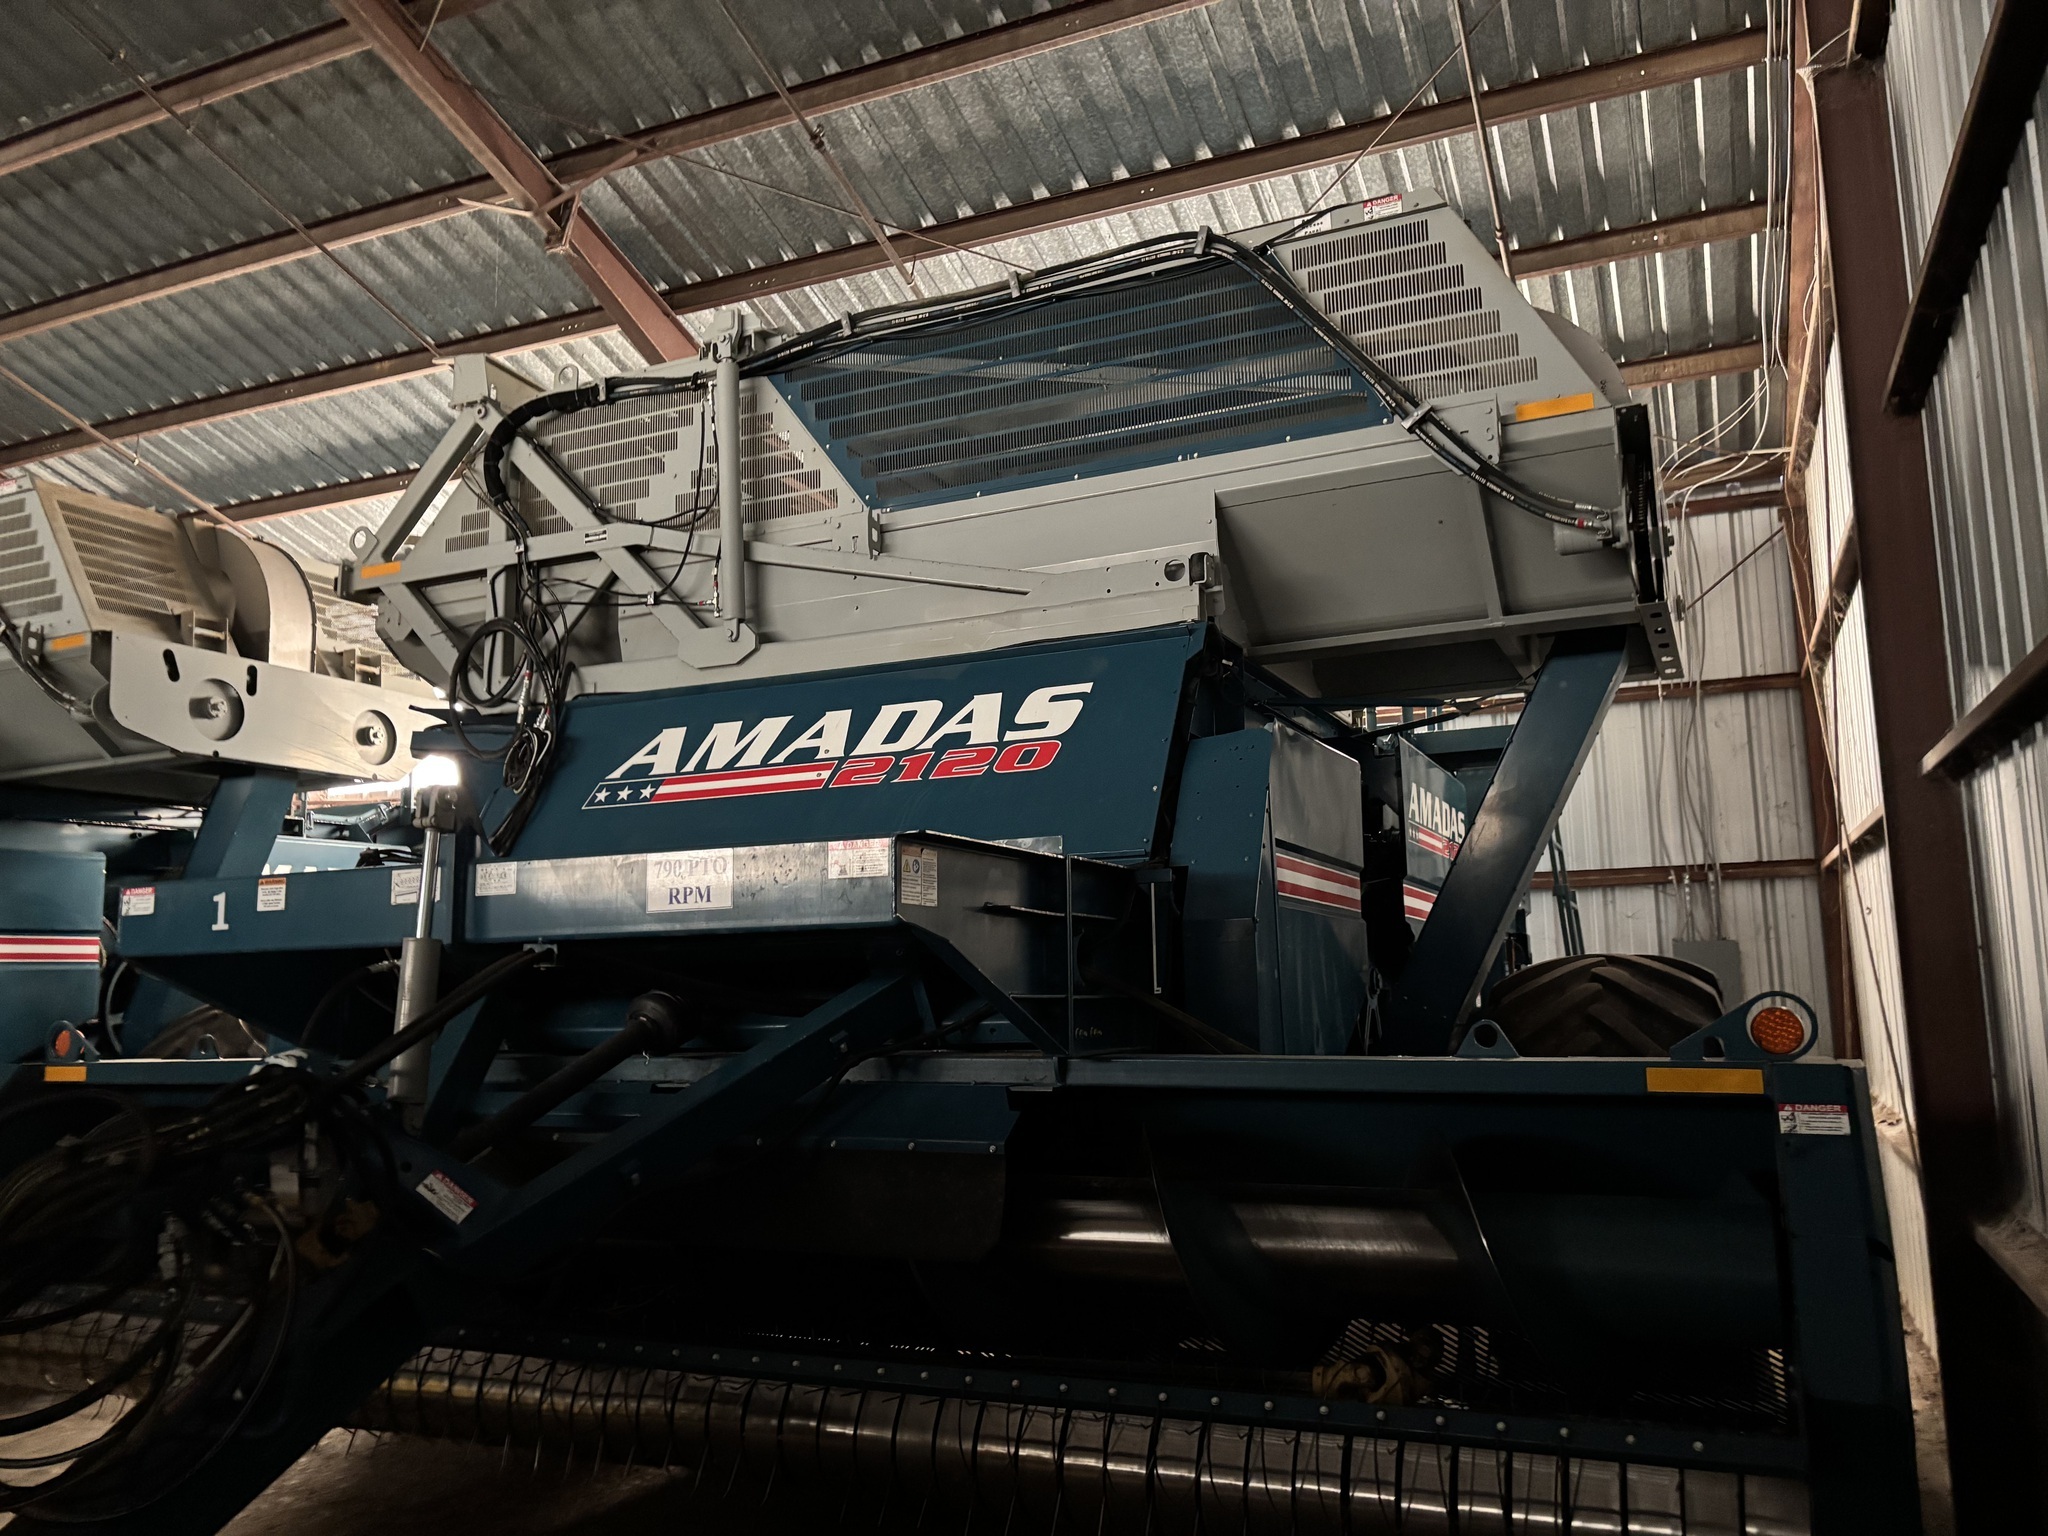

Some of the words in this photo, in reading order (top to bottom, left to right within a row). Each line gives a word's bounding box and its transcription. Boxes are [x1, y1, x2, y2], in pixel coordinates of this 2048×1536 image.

[1372, 195, 1399, 206] DANGER
[604, 682, 1094, 779] AMADAS
[829, 740, 1063, 788] 2120
[1408, 782, 1466, 844] AMADAS
[654, 859, 682, 878] 790
[688, 856, 728, 876] PTO
[668, 885, 712, 905] RPM
[211, 891, 230, 931] 1
[1794, 1104, 1842, 1112] DANGER
